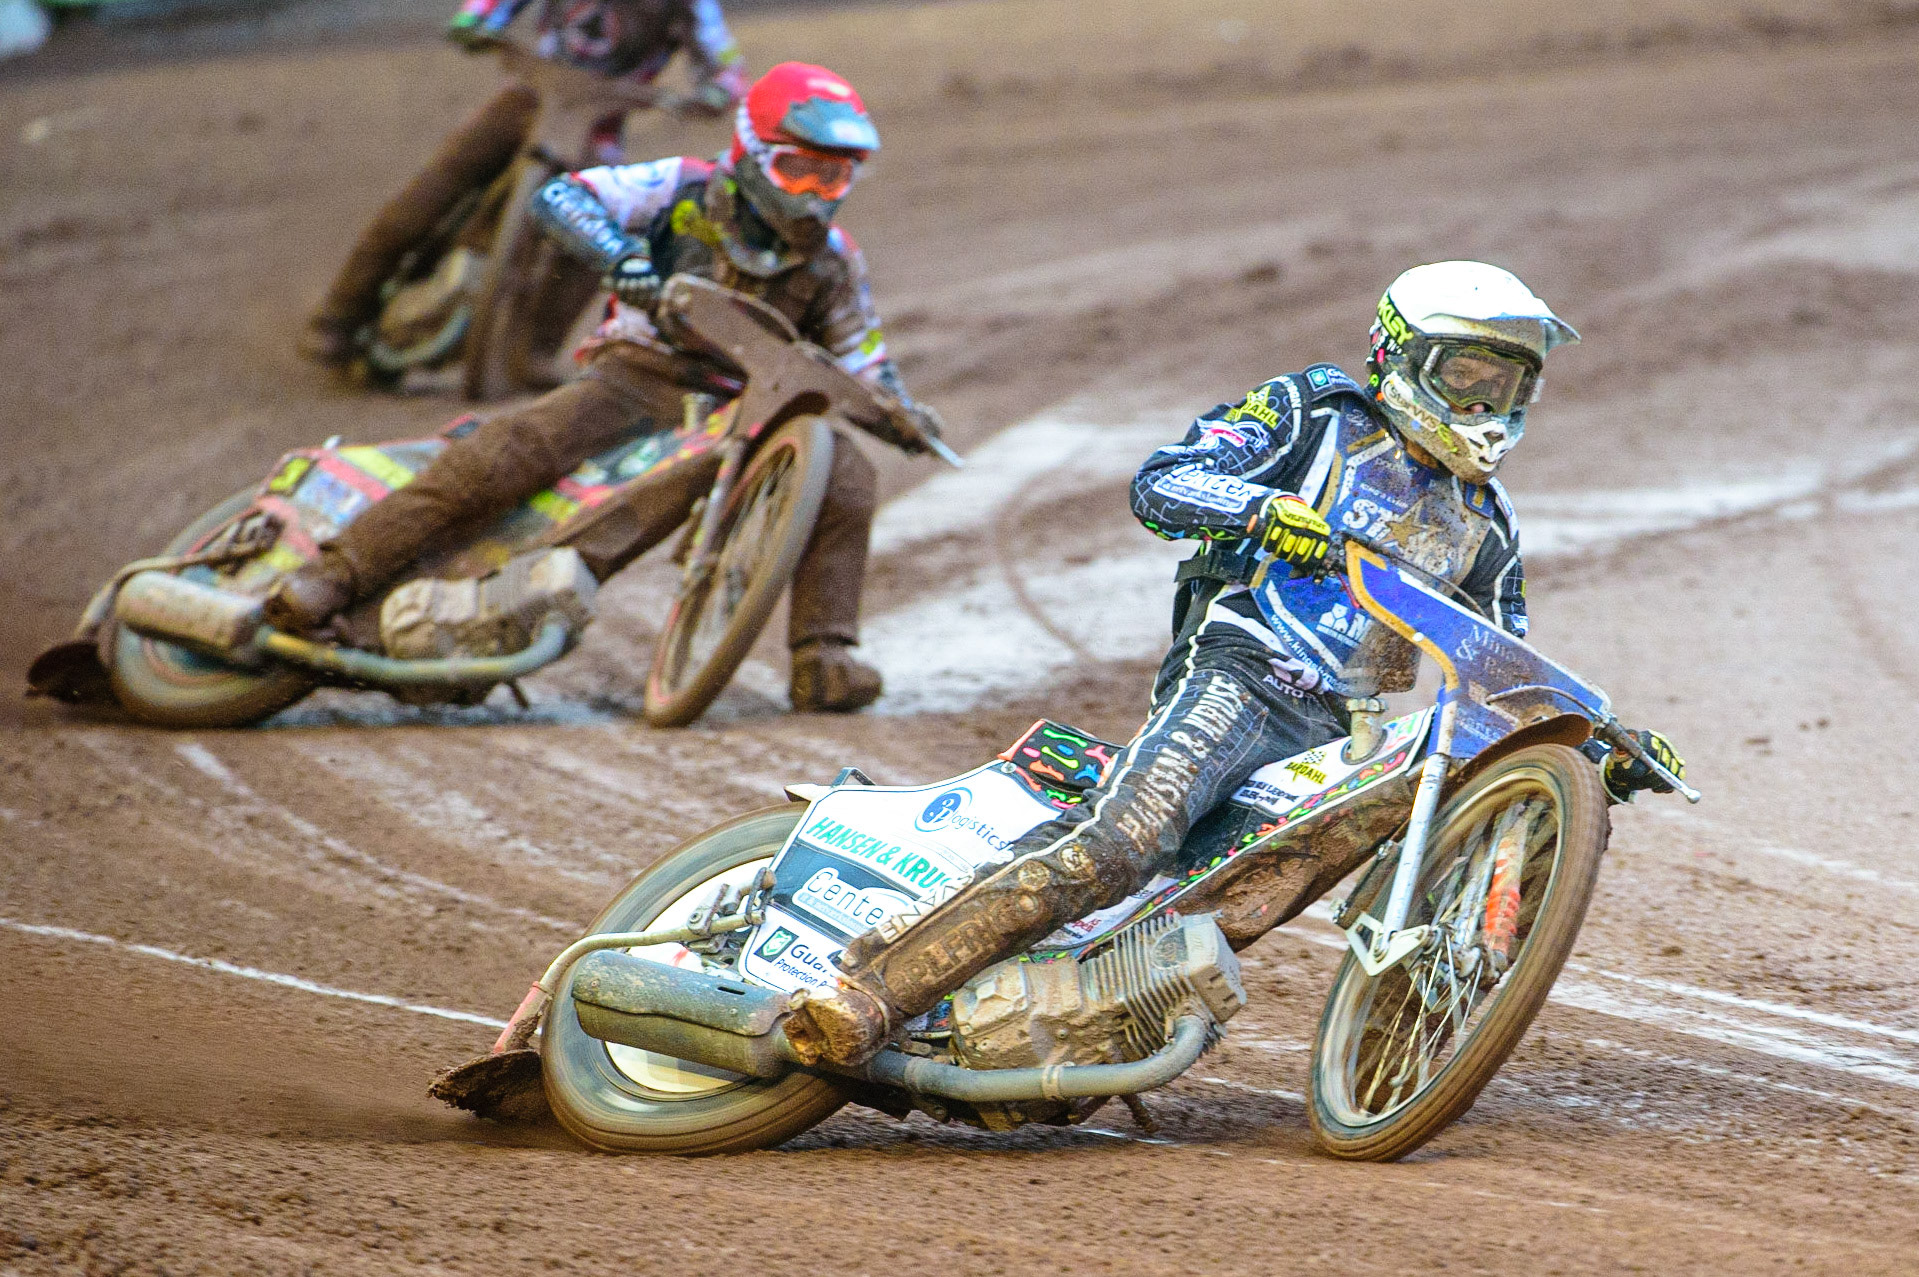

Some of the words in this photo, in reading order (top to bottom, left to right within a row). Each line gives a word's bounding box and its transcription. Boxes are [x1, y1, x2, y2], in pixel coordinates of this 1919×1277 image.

[1183, 675, 1244, 742] KRUSE
[806, 816, 887, 859] HANSEN
[876, 845, 901, 866] &
[892, 851, 951, 893] KRU
[806, 873, 885, 926] Cente
[774, 958, 818, 989] Protection
[790, 944, 834, 976] Gua
